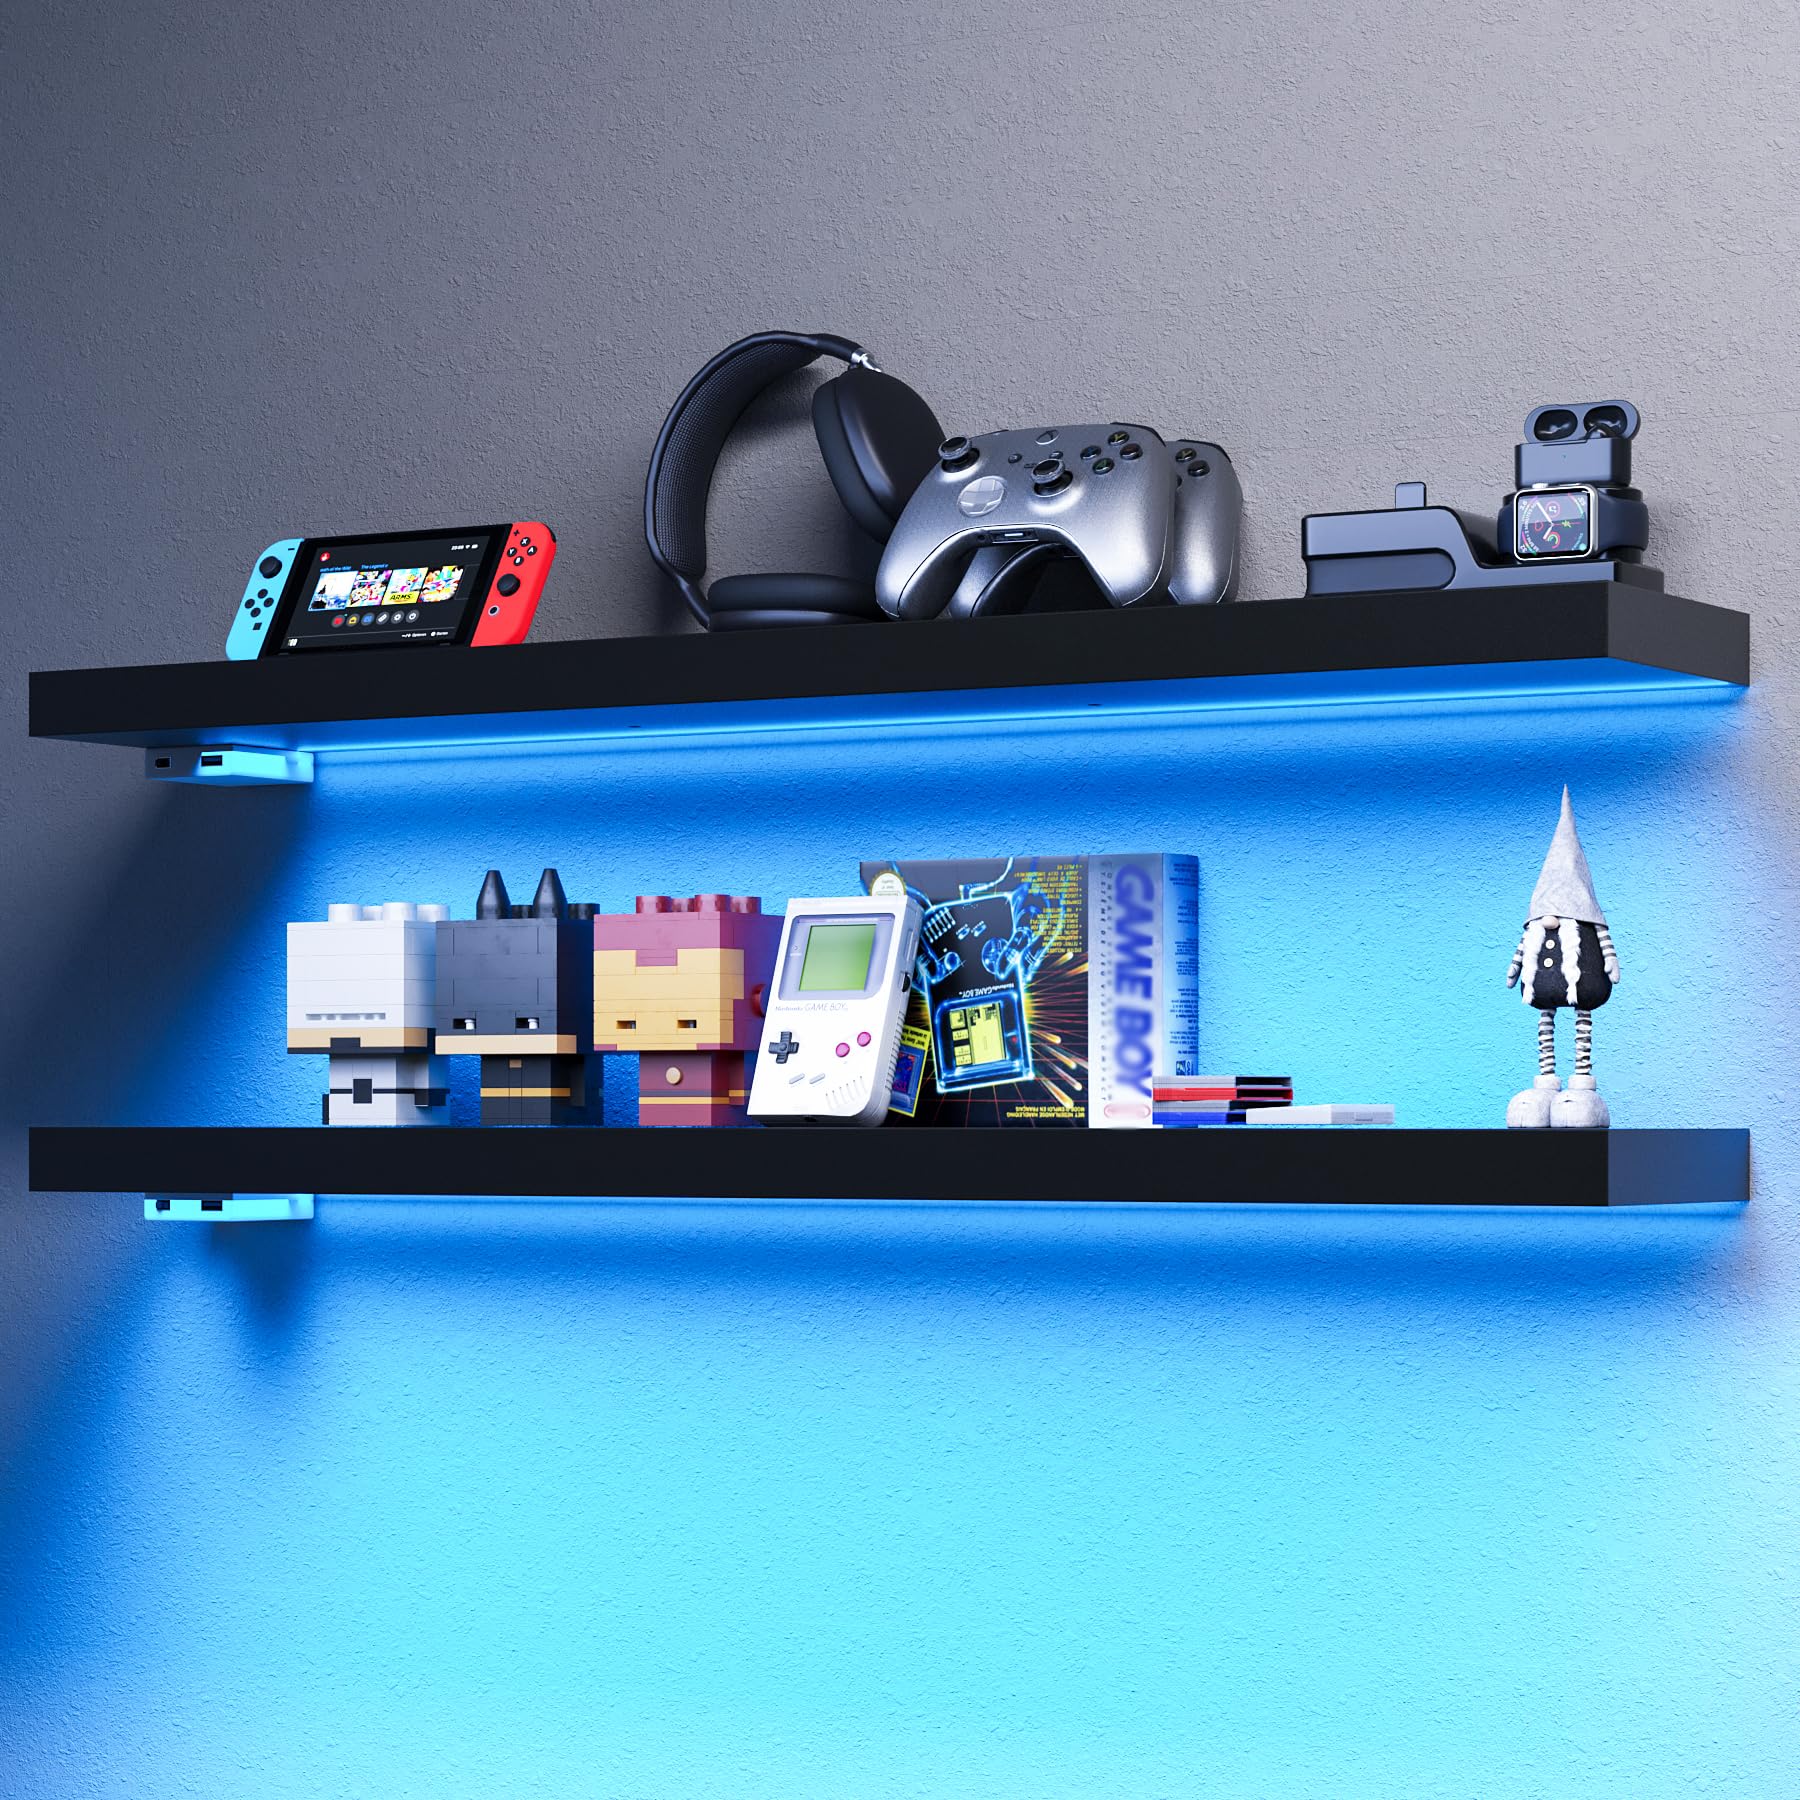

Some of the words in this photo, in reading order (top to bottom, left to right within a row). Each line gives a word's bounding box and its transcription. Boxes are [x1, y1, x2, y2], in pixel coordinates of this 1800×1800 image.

[1114, 863, 1154, 1000] GAME
[804, 1002, 829, 1012] GAME
[829, 1002, 847, 1012] BOY
[975, 986, 992, 997] GAME
[1114, 1007, 1154, 1099] BOY
